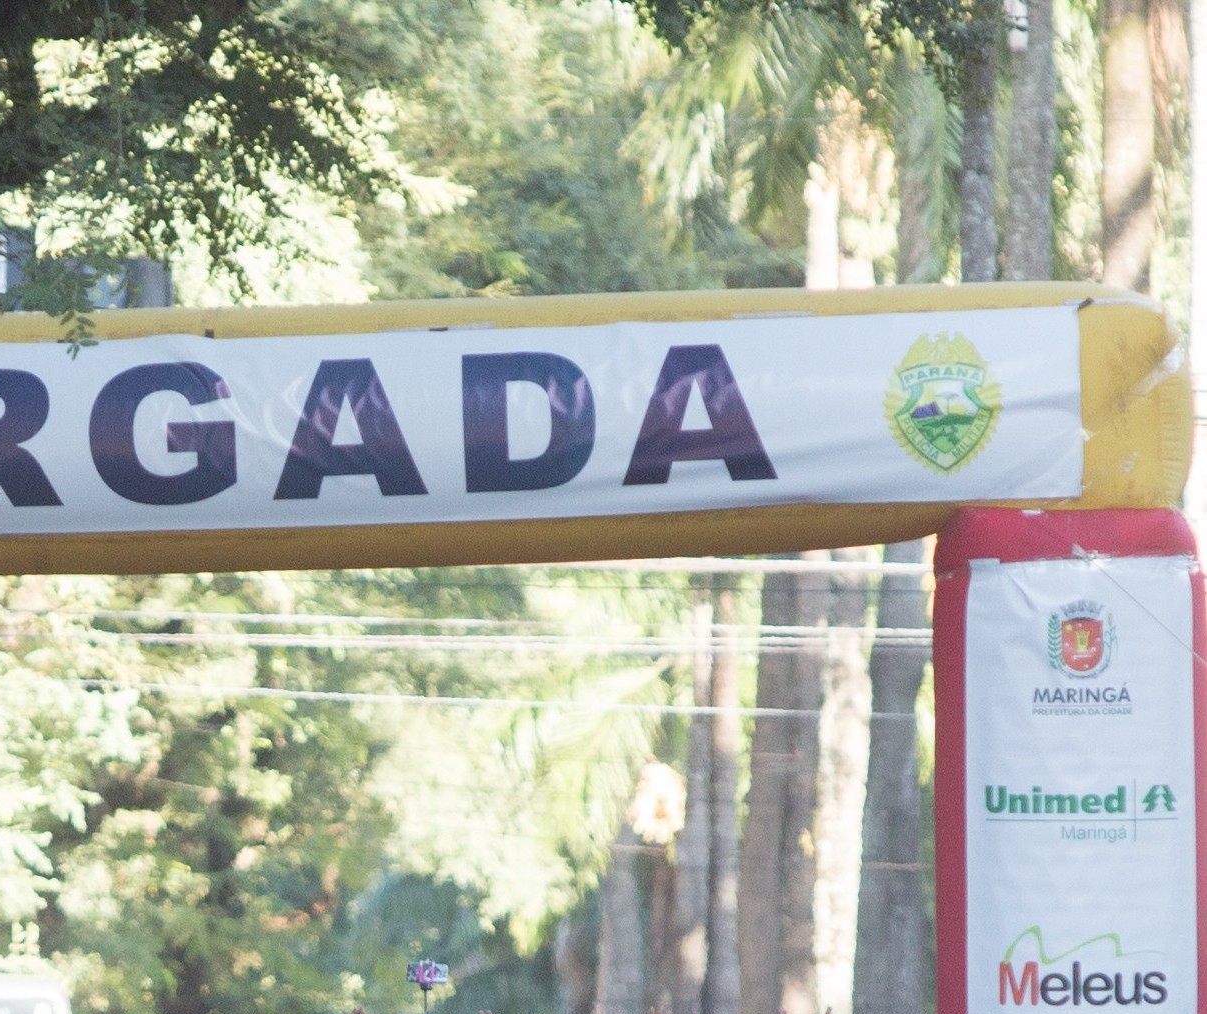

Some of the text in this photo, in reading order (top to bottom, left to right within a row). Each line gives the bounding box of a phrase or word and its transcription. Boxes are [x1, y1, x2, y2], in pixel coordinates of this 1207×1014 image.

[1033, 682, 1131, 703] MARINGÁ
[985, 785, 1126, 814] Unimed
[1061, 825, 1127, 843] Maringá
[998, 961, 1168, 1006] Meleus
